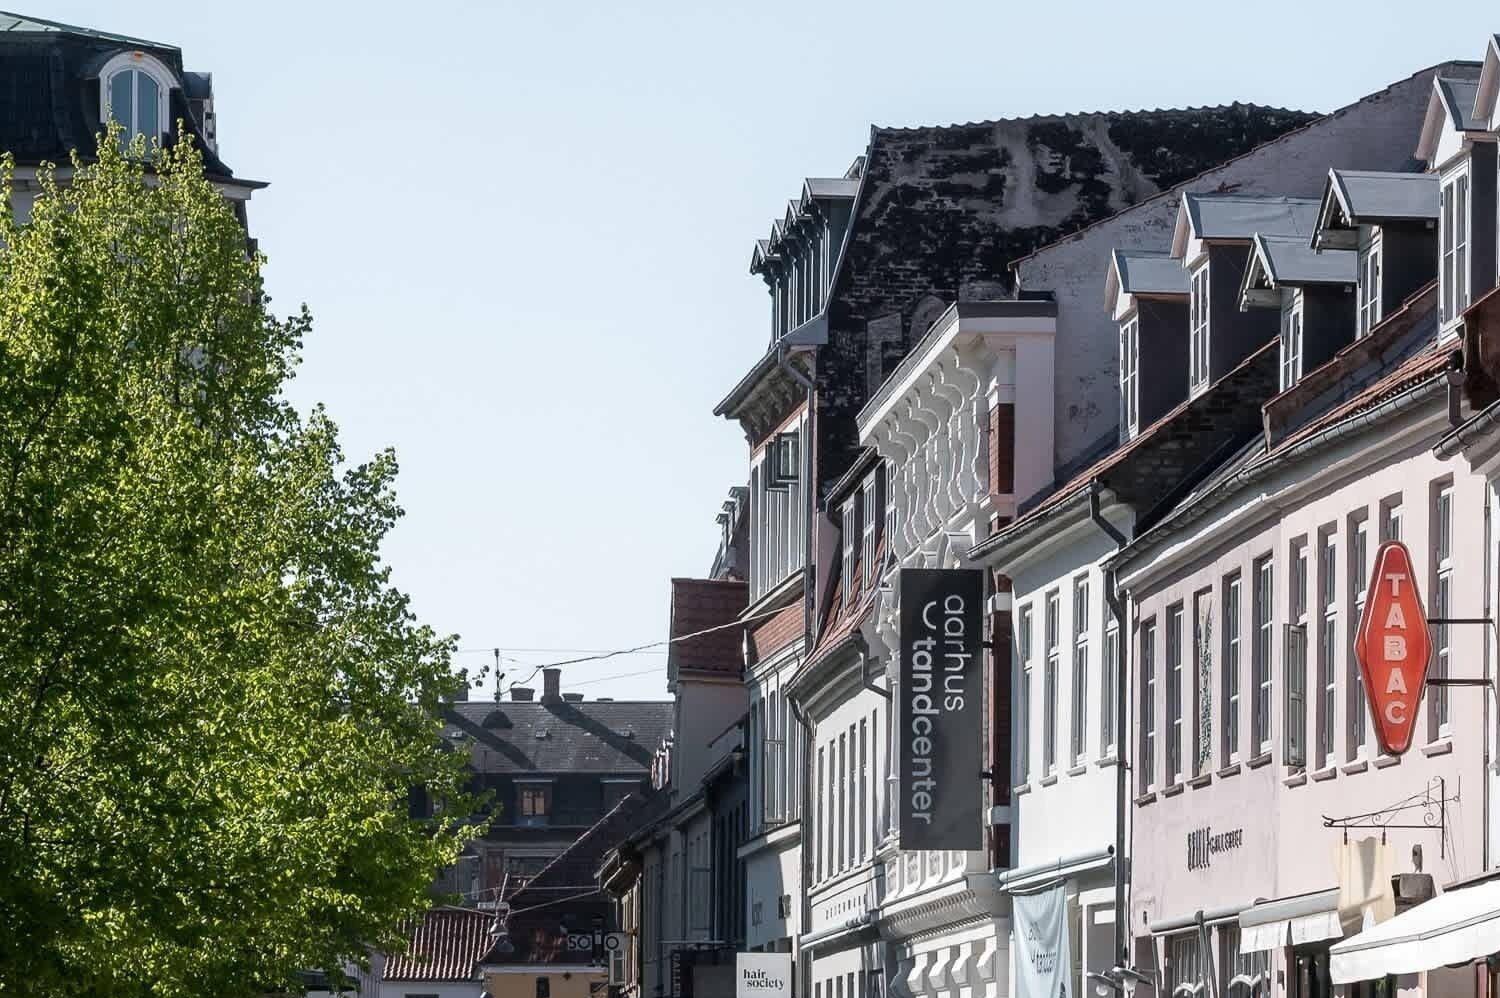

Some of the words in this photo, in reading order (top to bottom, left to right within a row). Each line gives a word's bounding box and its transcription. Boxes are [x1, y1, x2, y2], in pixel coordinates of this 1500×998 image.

[944, 594, 972, 712] aarhus
[1384, 573, 1407, 724] TABAC
[912, 636, 940, 825] tandcenter
[743, 968, 767, 979] hair
[746, 977, 784, 991] society
